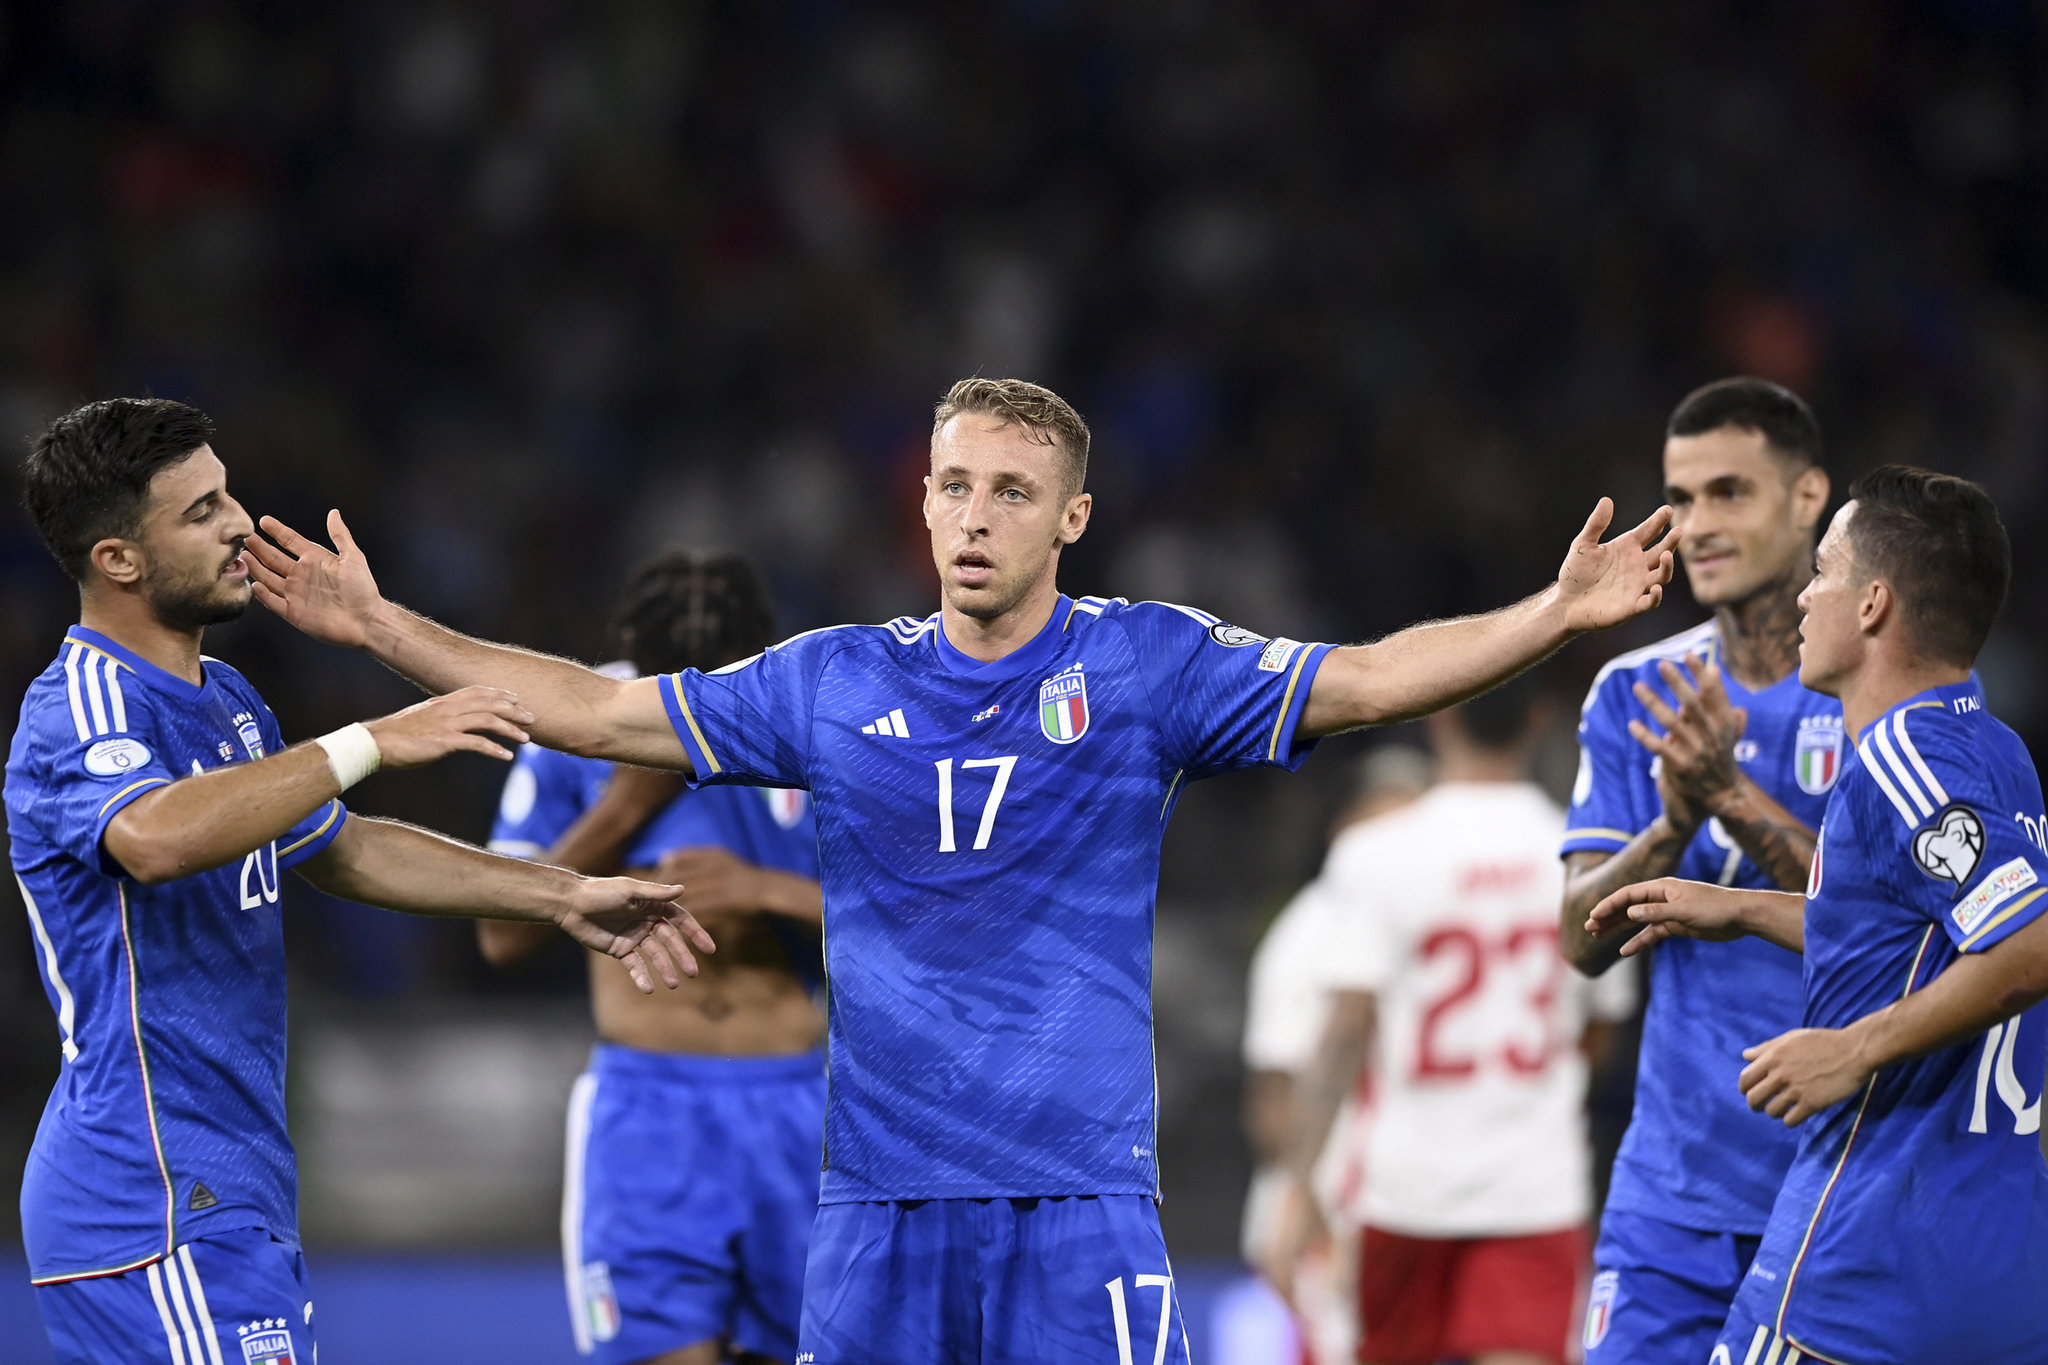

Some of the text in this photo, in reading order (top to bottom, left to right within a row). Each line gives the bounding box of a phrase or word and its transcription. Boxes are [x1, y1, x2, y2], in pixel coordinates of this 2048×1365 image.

[1042, 677, 1081, 700] ITALIA
[1260, 650, 1271, 668] UEFA
[934, 755, 1019, 852] 17
[240, 839, 279, 911] 20
[1414, 921, 1564, 1077] 23
[245, 1335, 288, 1356] ITALIA
[1104, 1273, 1171, 1365] 17
